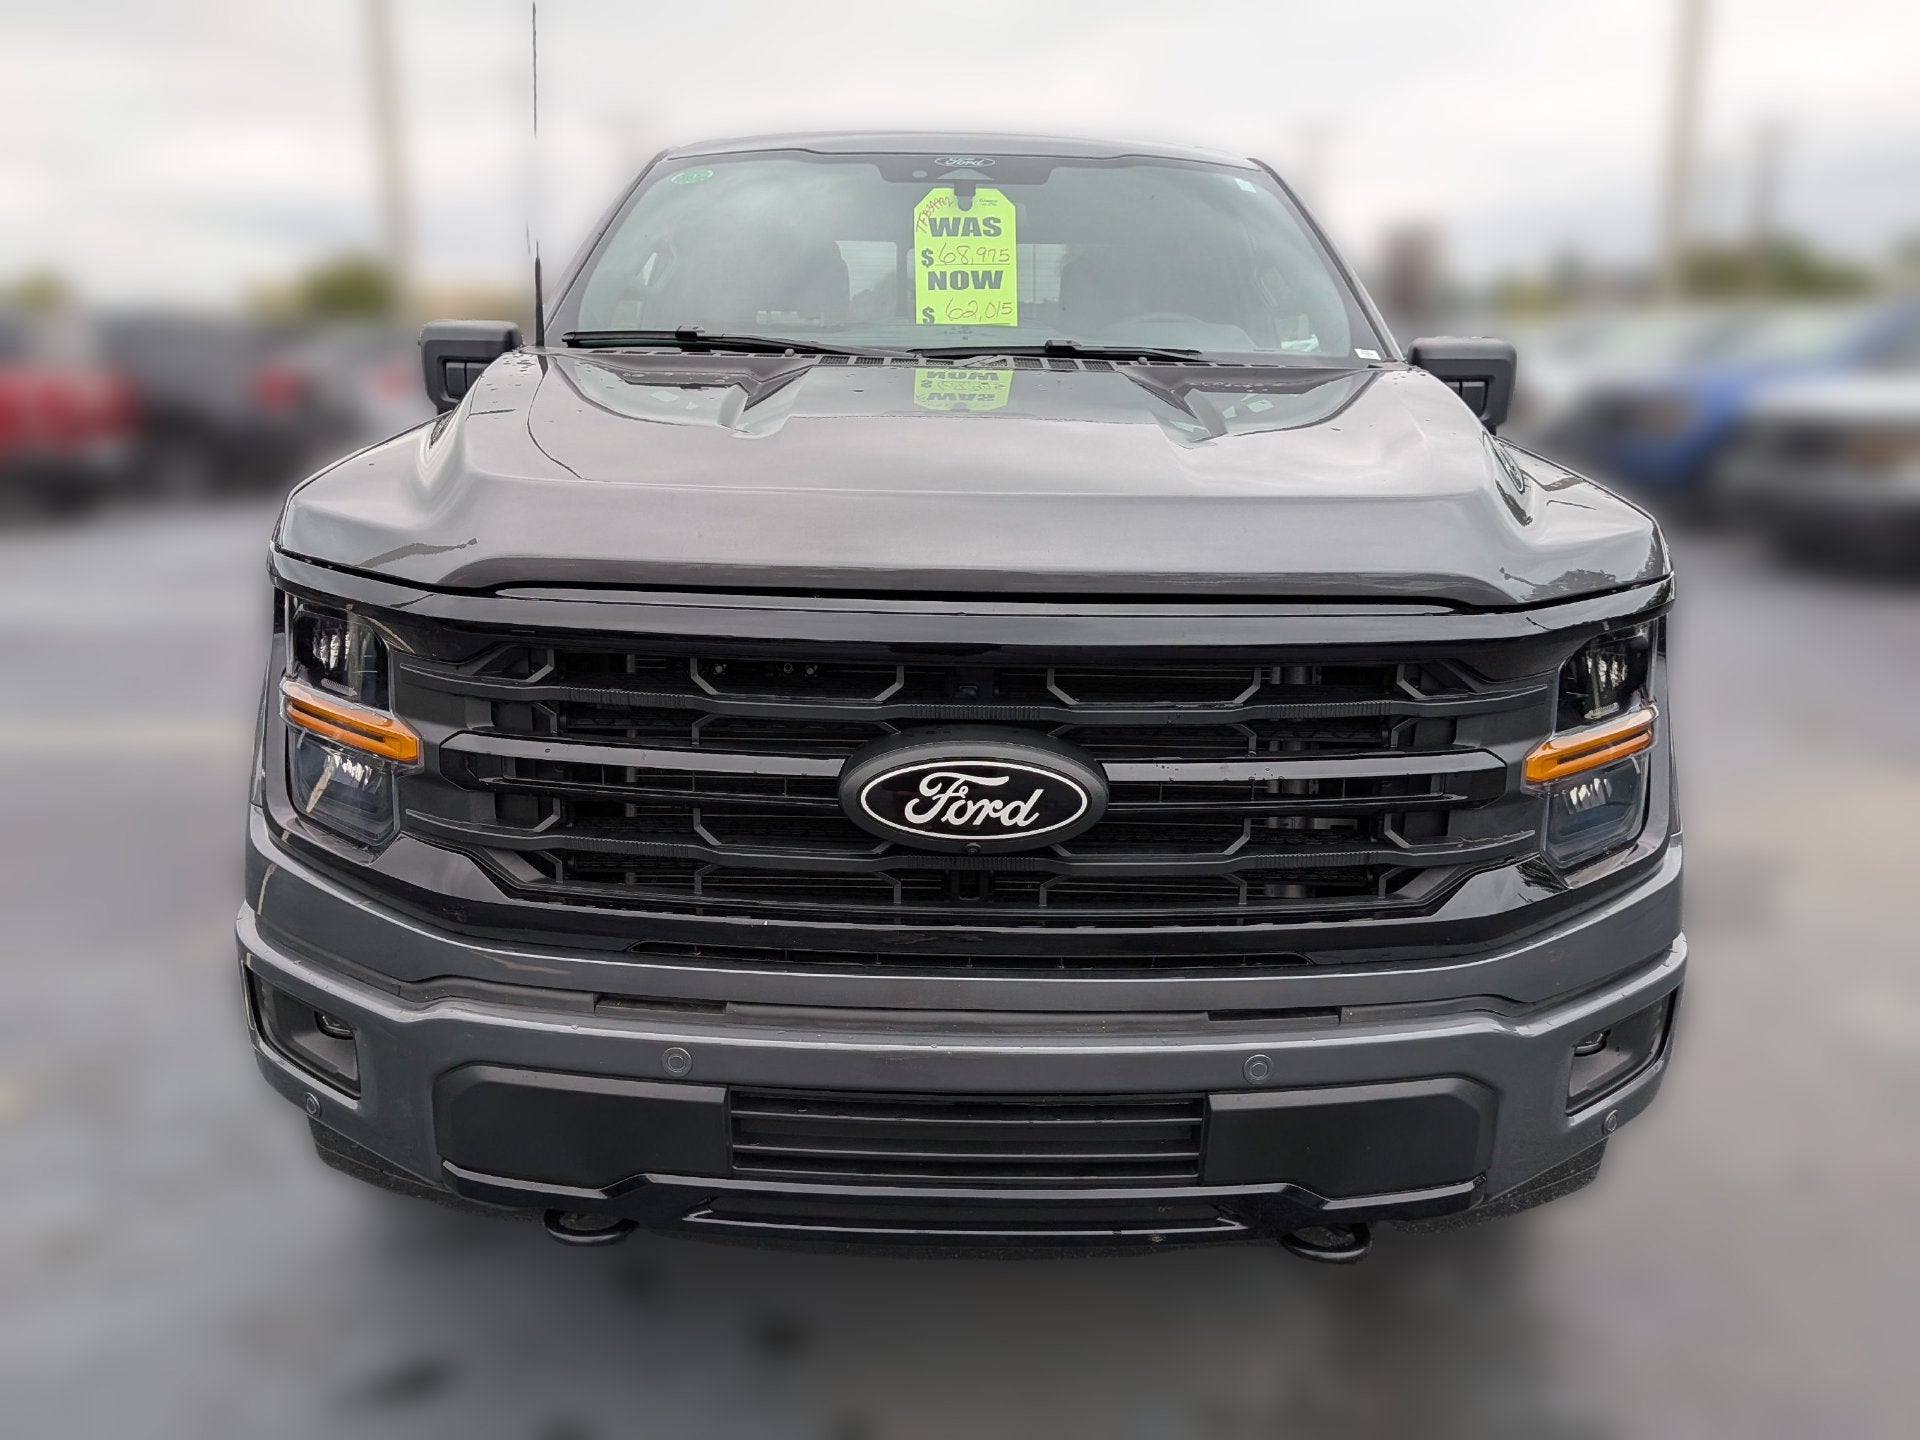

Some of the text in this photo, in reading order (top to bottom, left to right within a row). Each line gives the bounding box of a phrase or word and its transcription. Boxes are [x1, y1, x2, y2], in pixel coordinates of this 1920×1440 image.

[945, 157, 985, 166] Ford
[928, 216, 1002, 237] WAS
[921, 242, 1011, 268] $ 68,975
[927, 270, 1004, 291] NOW
[921, 297, 1013, 325] $ 62,015
[904, 771, 1045, 827] Ford
